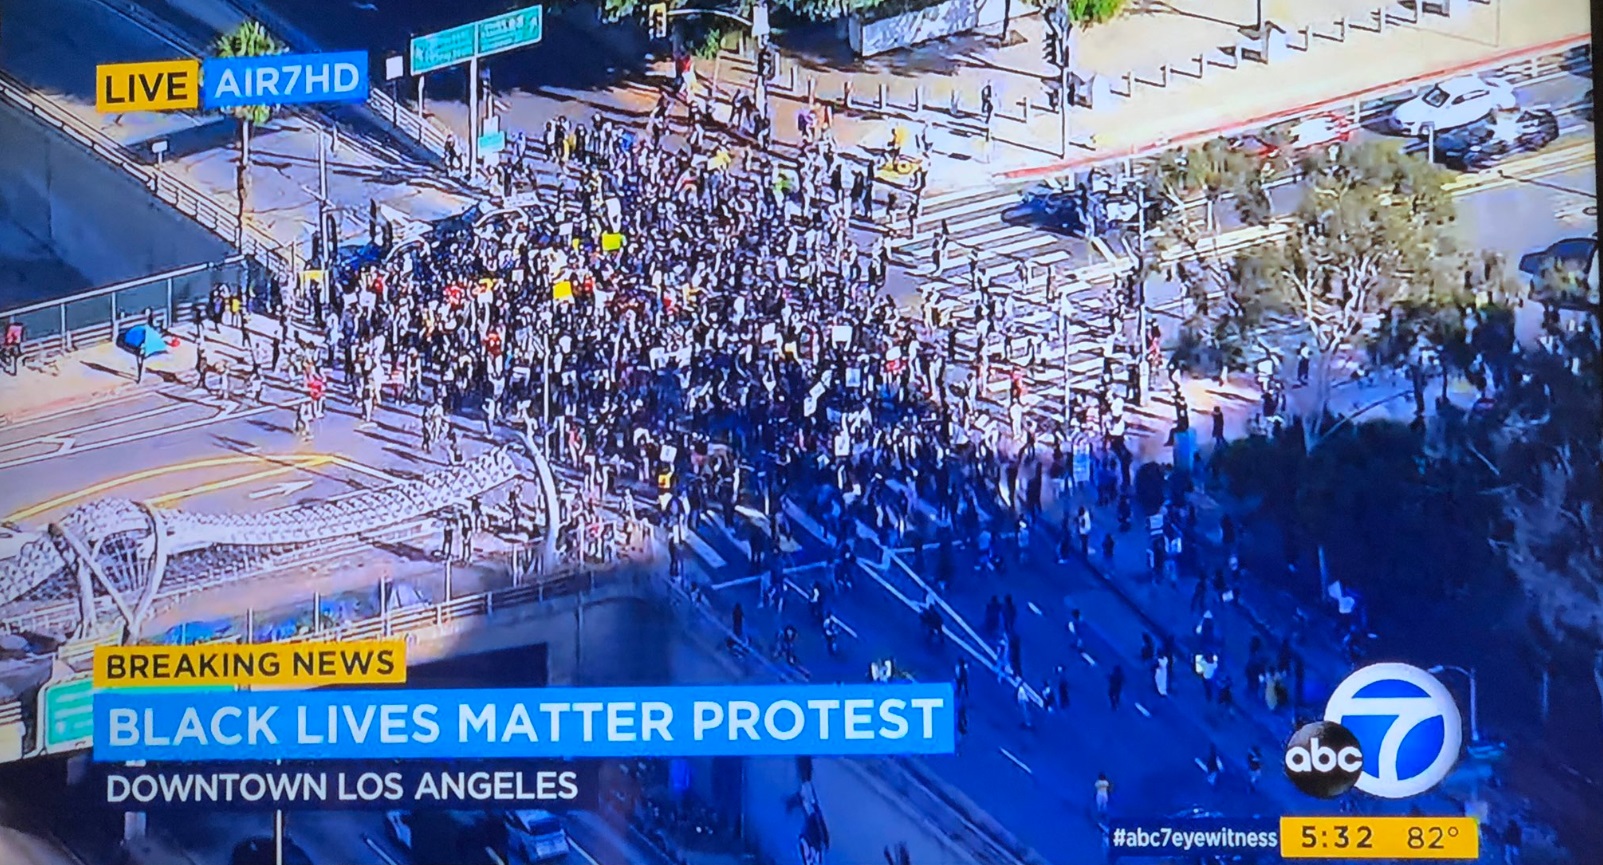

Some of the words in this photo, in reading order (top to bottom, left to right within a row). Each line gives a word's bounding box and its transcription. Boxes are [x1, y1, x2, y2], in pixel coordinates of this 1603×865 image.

[105, 72, 189, 104] LIVE
[215, 63, 360, 104] AIR7HD
[107, 653, 281, 679] BREAKING
[292, 650, 395, 676] NEWS
[109, 707, 280, 745] BLACK
[298, 704, 440, 743] LIVES
[458, 703, 674, 742] MATTER
[693, 698, 943, 740] PROTEST
[1285, 738, 1363, 774] abc
[107, 773, 326, 802] DOWNTOWN
[338, 772, 404, 800] LOS
[416, 771, 578, 800] ANGELES
[1113, 828, 1278, 850] #abc7eyewitness
[1301, 826, 1374, 849] 5:32
[1407, 826, 1460, 850] 82°
